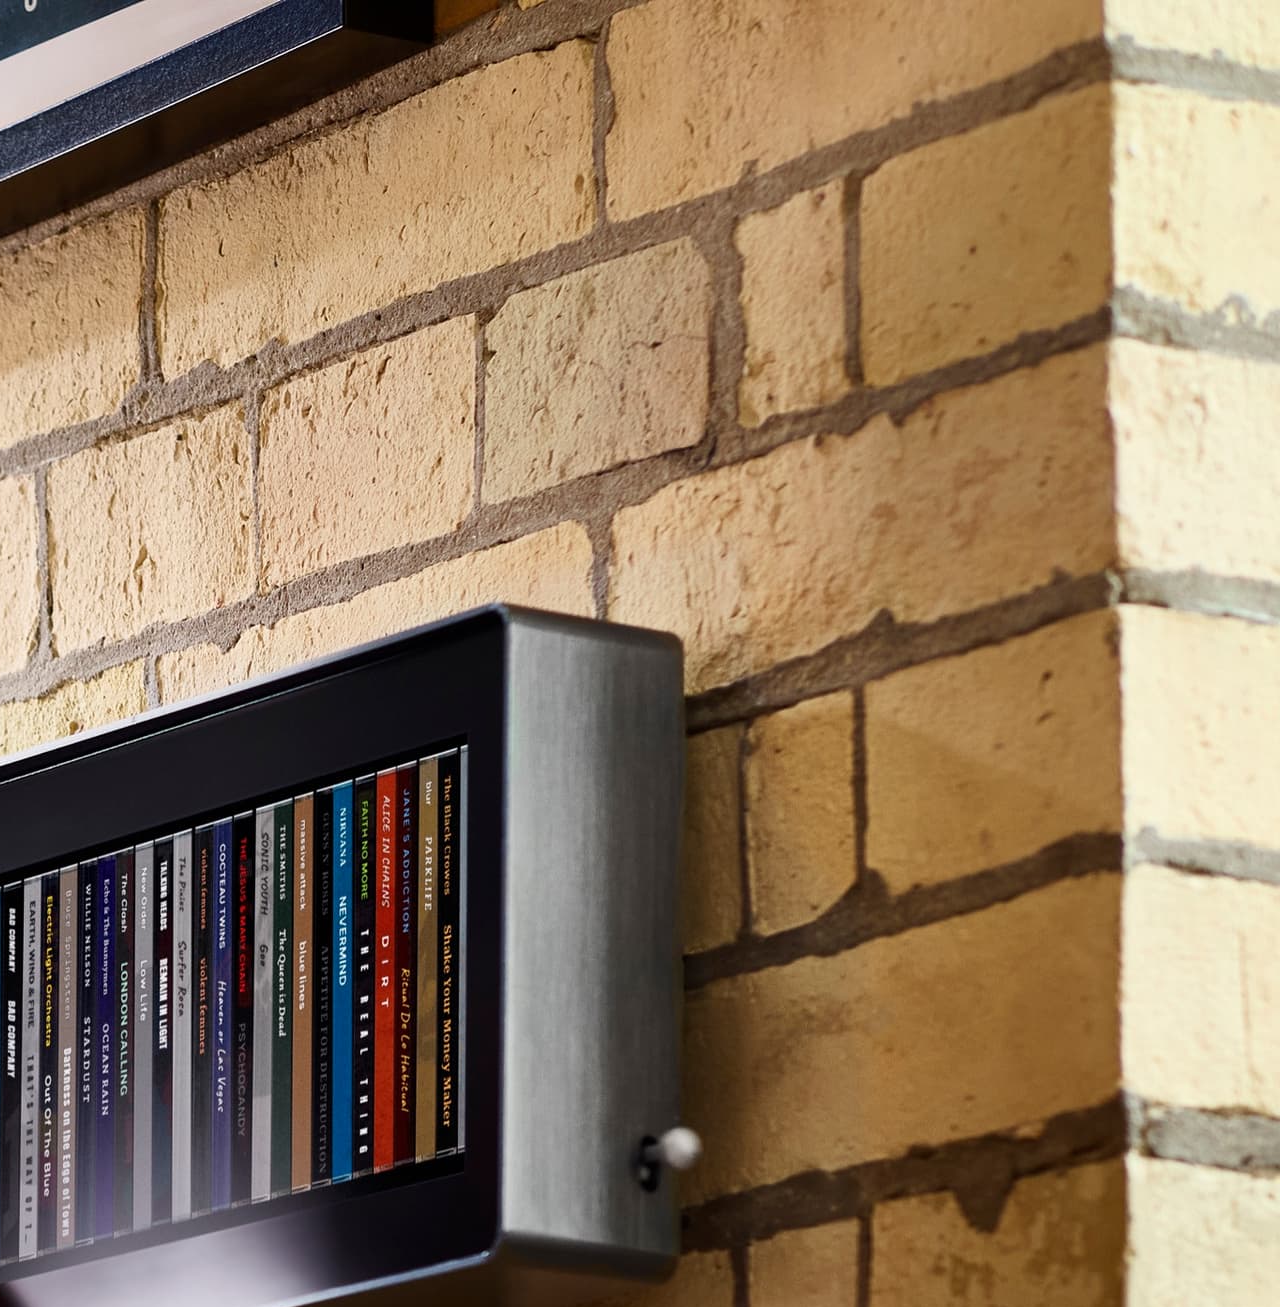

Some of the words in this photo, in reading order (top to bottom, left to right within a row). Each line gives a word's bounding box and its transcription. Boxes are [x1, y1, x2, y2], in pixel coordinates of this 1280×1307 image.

[425, 781, 433, 805] blur
[444, 775, 452, 801] The
[361, 800, 369, 838] FAITH
[382, 795, 391, 832] ALICE
[444, 804, 452, 842] Black
[279, 825, 287, 850] THE
[340, 807, 348, 867] NIRVANA
[361, 840, 369, 860] NO
[382, 838, 390, 854] IN
[121, 873, 129, 896] The
[361, 862, 369, 899] MORE
[381, 857, 391, 908] CHAINS
[424, 836, 433, 911] PARKLIFE
[444, 845, 452, 896] Crowes
[8, 907, 16, 926] BAD
[46, 895, 54, 944] Electric
[85, 883, 93, 931] WILLIE
[121, 898, 129, 933] Clash
[160, 900, 168, 931] HEADS
[8, 928, 16, 973] COMPANY
[279, 928, 287, 951] The
[299, 940, 307, 972] blue
[338, 895, 347, 986] NEVERMIND
[360, 929, 370, 972] THE
[443, 924, 452, 973] Shake
[45, 947, 53, 981] Light
[84, 935, 92, 987] NELSON
[140, 959, 148, 989] Low
[277, 953, 286, 991] Queen
[381, 935, 390, 1007] DIRT
[120, 962, 129, 1026] LONDON
[159, 958, 168, 1002] REMAIN
[278, 993, 286, 1004] is
[299, 975, 307, 1010] lines
[443, 977, 452, 1014] Your
[7, 1000, 16, 1022] BAD
[45, 984, 53, 1047] Orchestra
[140, 993, 148, 1021] Life
[159, 1003, 168, 1017] IN
[278, 1006, 286, 1037] Dead
[359, 995, 369, 1055] REAL
[7, 1024, 16, 1078] COMPANY
[159, 1018, 168, 1049] LIGHT
[442, 1019, 452, 1072] Money
[82, 1016, 91, 1103] STARDUST
[120, 1029, 128, 1096] CALLING
[44, 1074, 52, 1104] Out
[443, 1076, 452, 1127] Maker
[44, 1107, 52, 1125] Of
[359, 1078, 369, 1154] THING
[44, 1129, 52, 1158] The
[43, 1162, 51, 1197] Blue
